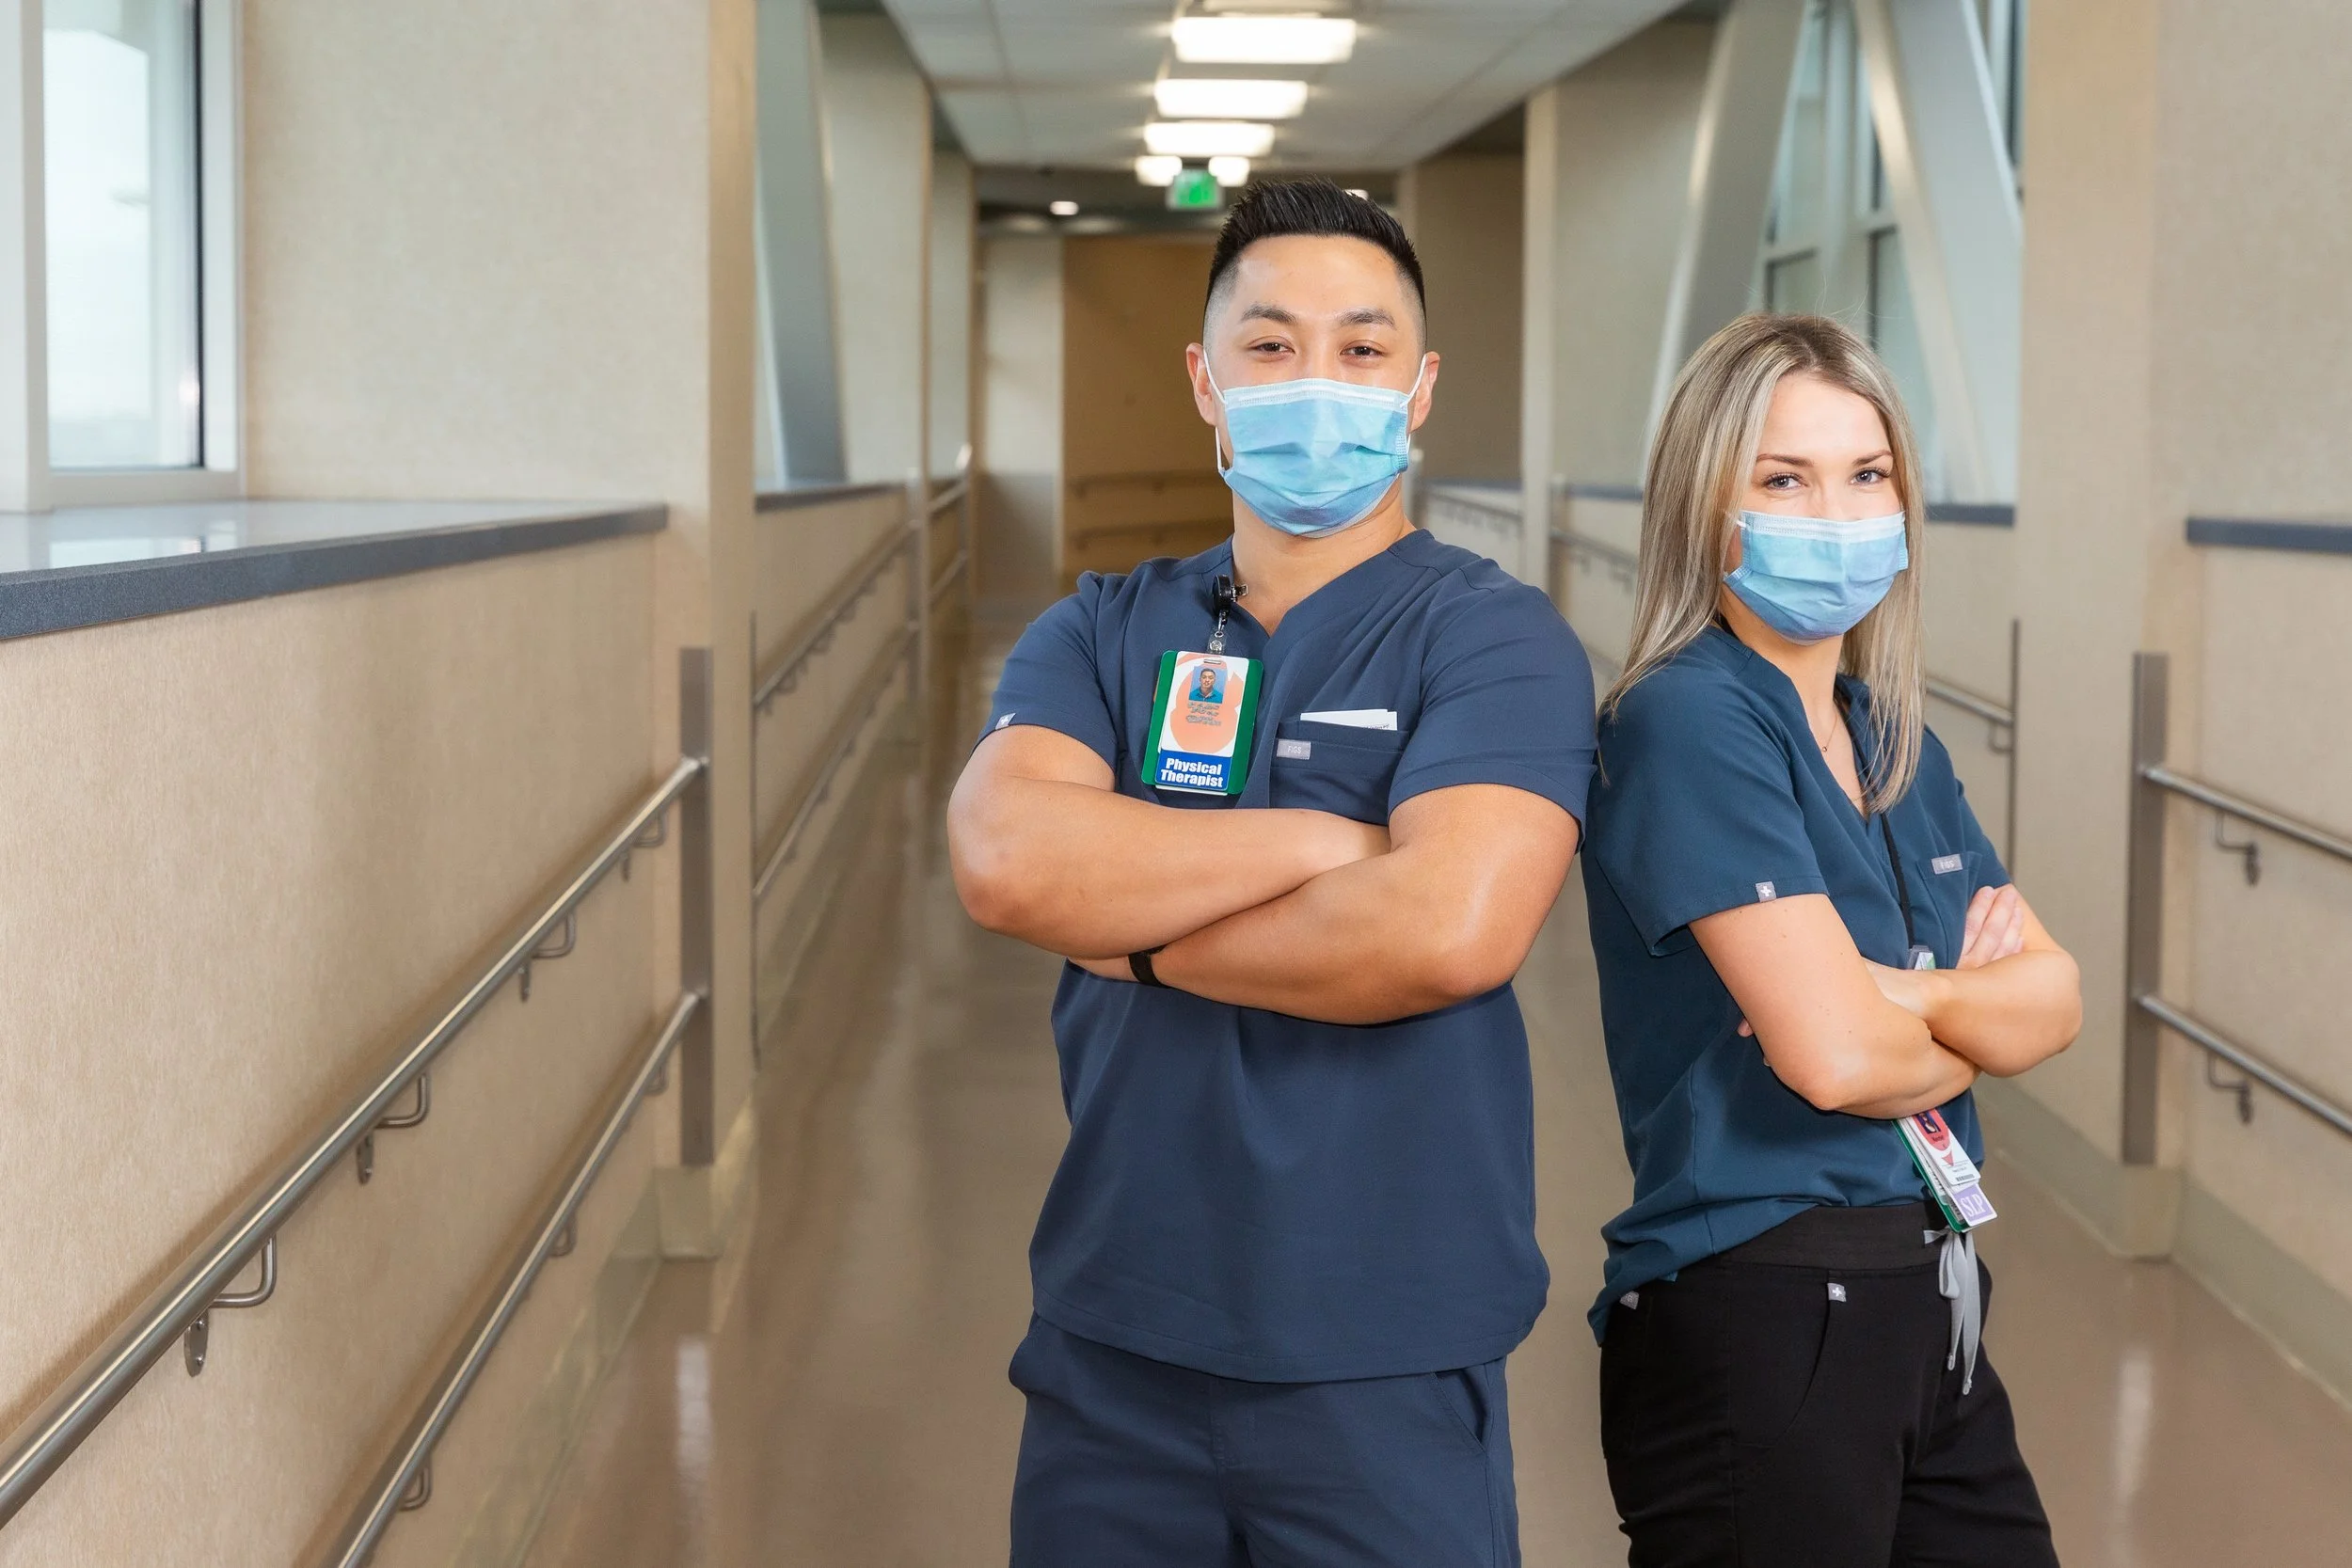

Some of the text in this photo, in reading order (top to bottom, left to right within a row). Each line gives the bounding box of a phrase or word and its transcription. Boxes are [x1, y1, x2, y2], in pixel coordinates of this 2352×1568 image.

[1166, 757, 1222, 775] Physical
[1160, 769, 1223, 787] Therapist
[1961, 1194, 1986, 1216] SLP
